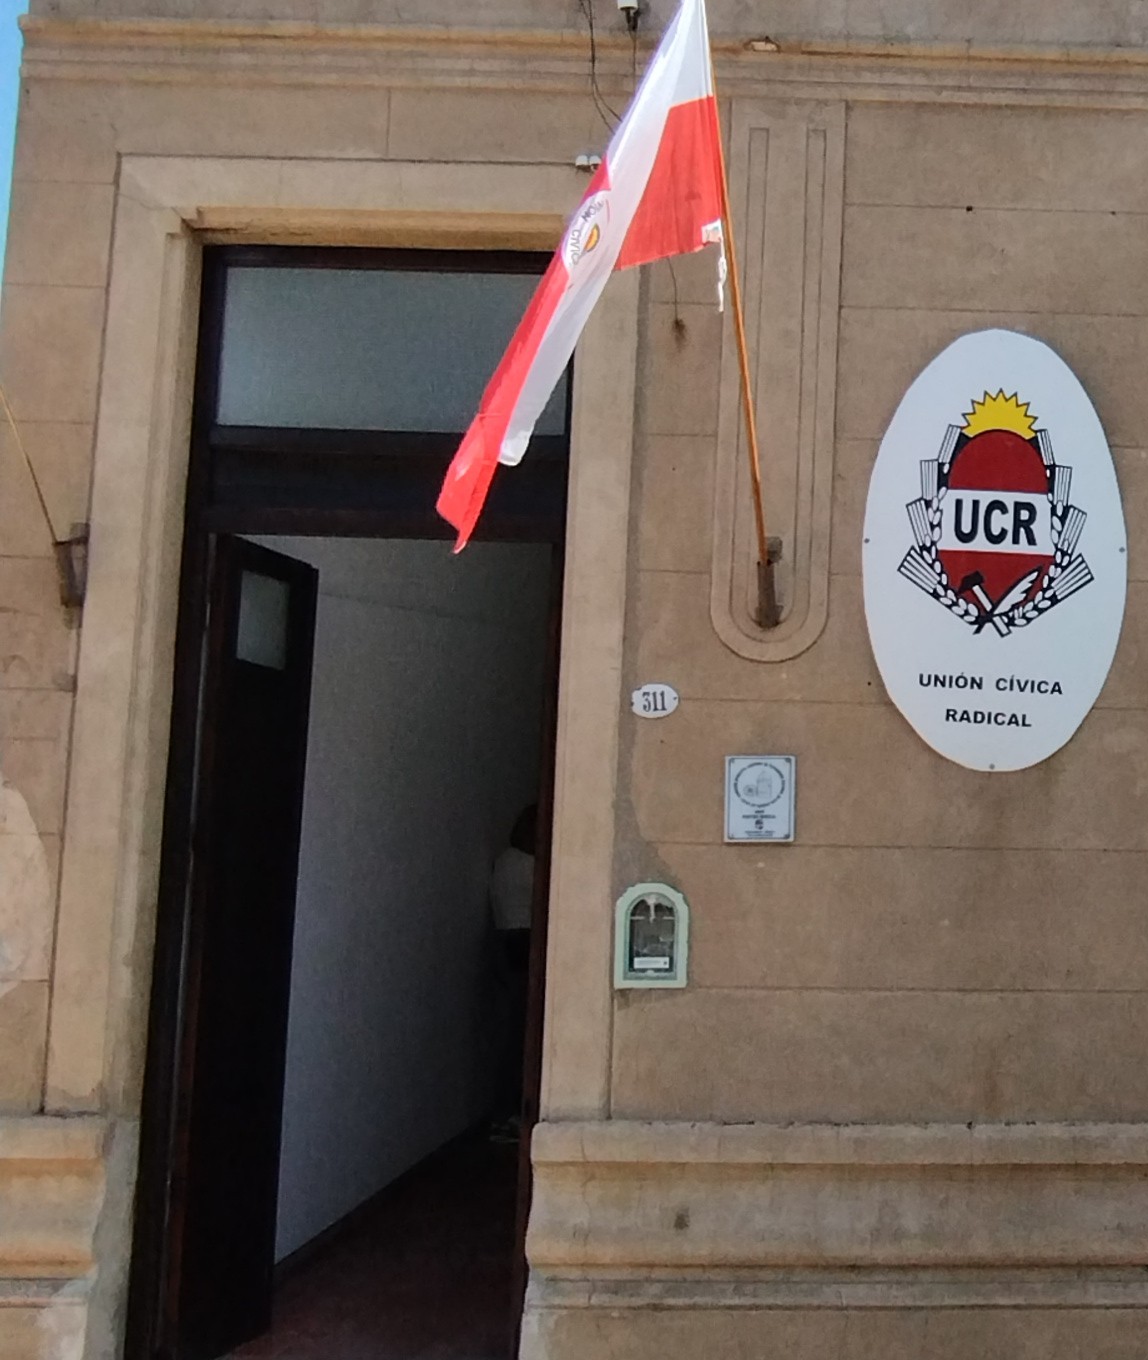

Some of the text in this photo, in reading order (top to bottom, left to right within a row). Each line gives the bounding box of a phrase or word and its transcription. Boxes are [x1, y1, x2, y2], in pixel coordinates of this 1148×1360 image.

[954, 498, 1038, 546] UCR
[919, 672, 1063, 695] UNIÓN CÍVICA
[642, 690, 667, 713] 311
[945, 708, 1032, 727] RADICAL
